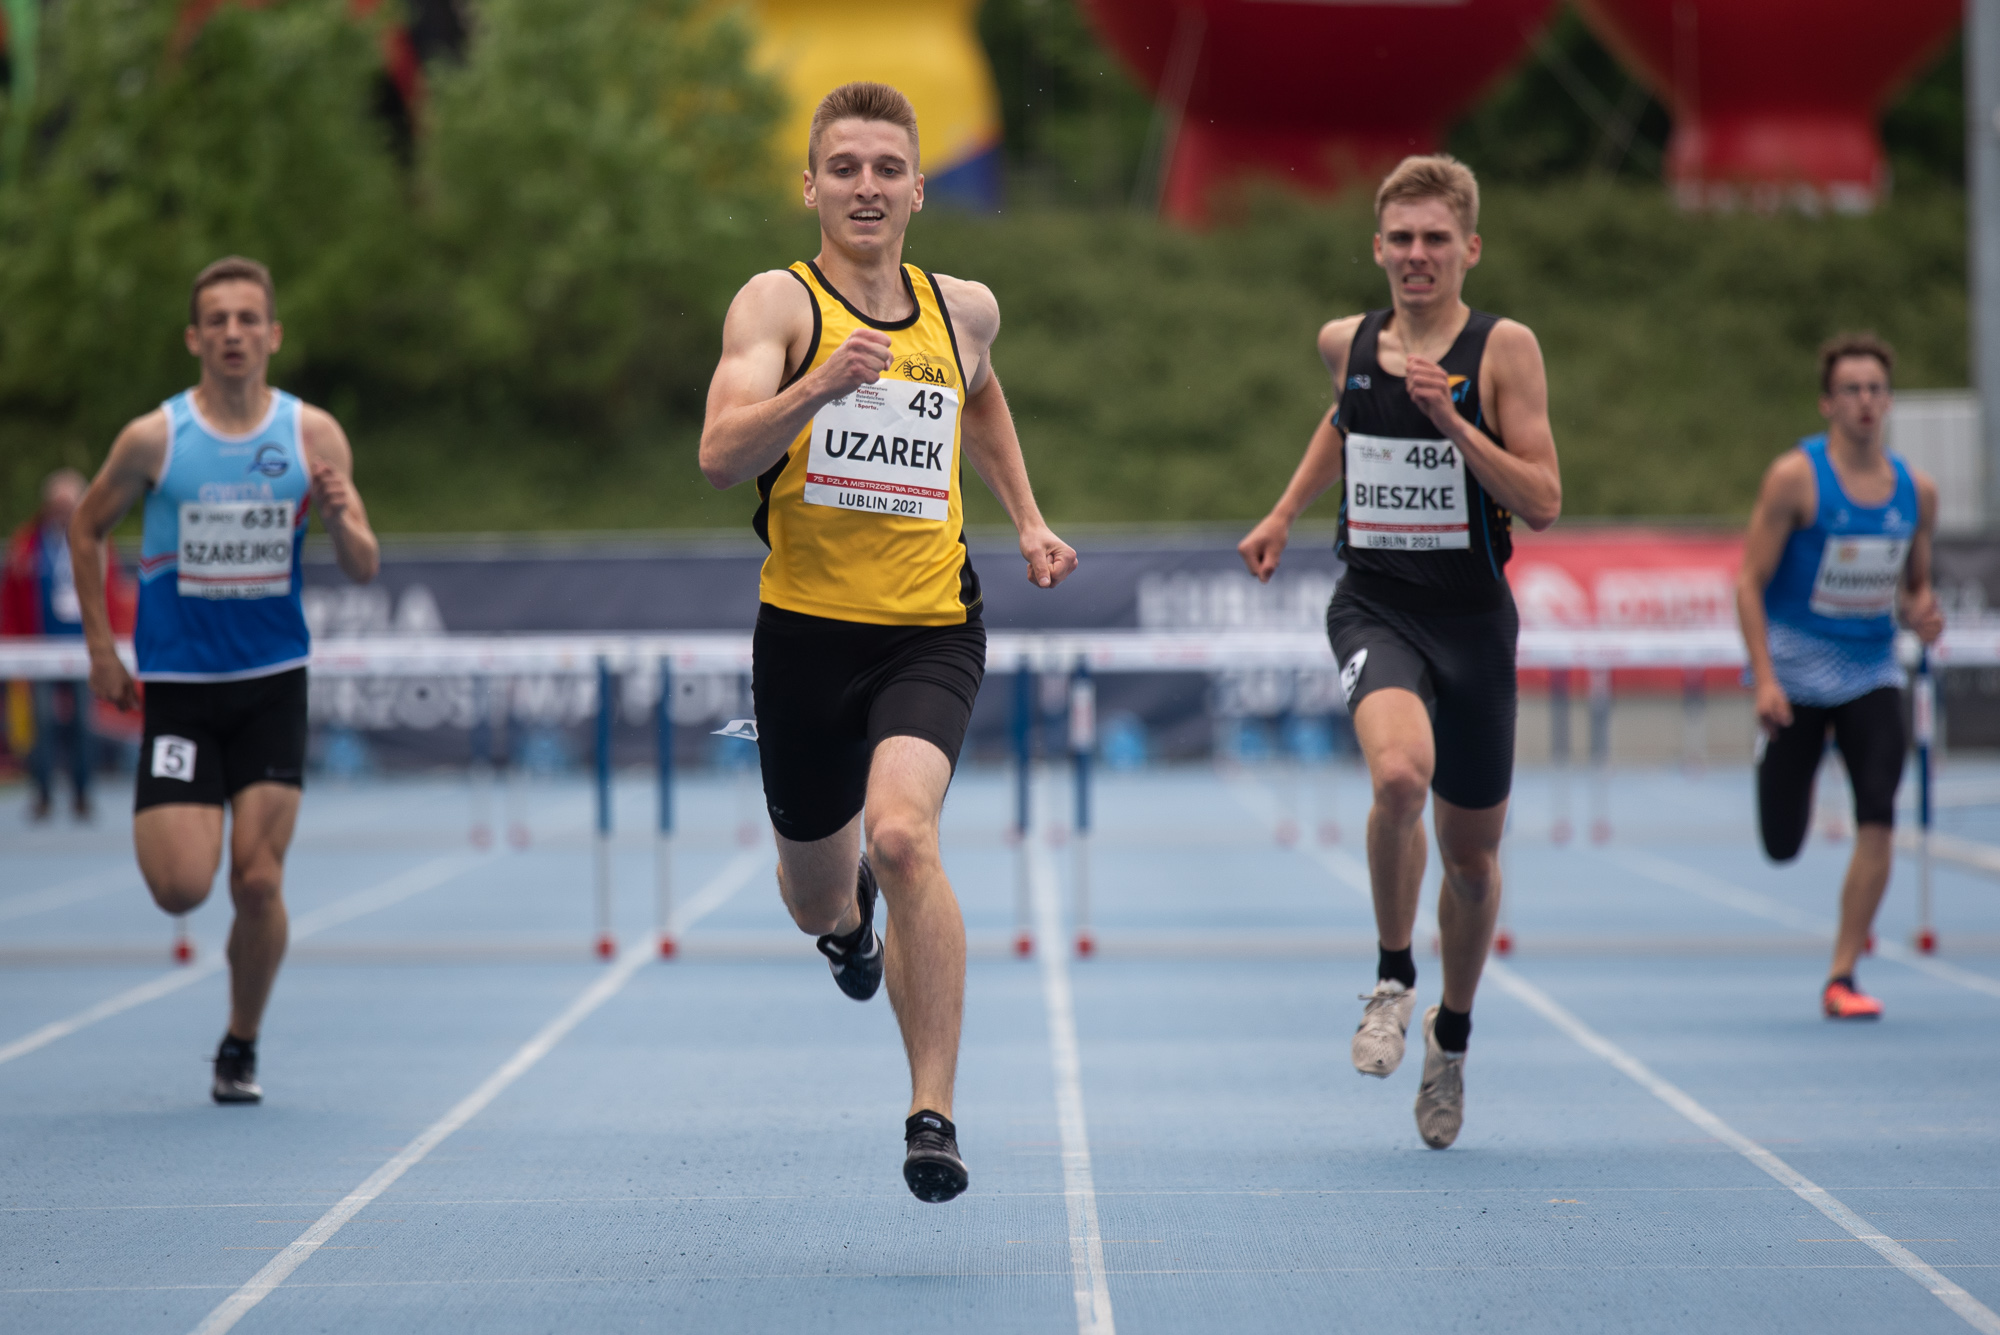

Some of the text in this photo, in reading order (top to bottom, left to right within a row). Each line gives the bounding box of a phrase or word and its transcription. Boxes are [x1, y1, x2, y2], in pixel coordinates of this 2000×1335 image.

[910, 364, 946, 384] OSA
[908, 389, 944, 420] 43
[825, 428, 944, 471] UZAREK
[1405, 446, 1457, 469] 484
[813, 475, 945, 498] 75. PZLA MISTRZOSTWA POLSKI U20
[1355, 483, 1455, 510] BIESZKE
[838, 492, 923, 514] LUBLIN 2021
[242, 507, 288, 529] 631
[1366, 533, 1440, 548] LUBLIN 2021
[184, 540, 289, 565] SZAREJKO
[164, 743, 185, 775] 5
